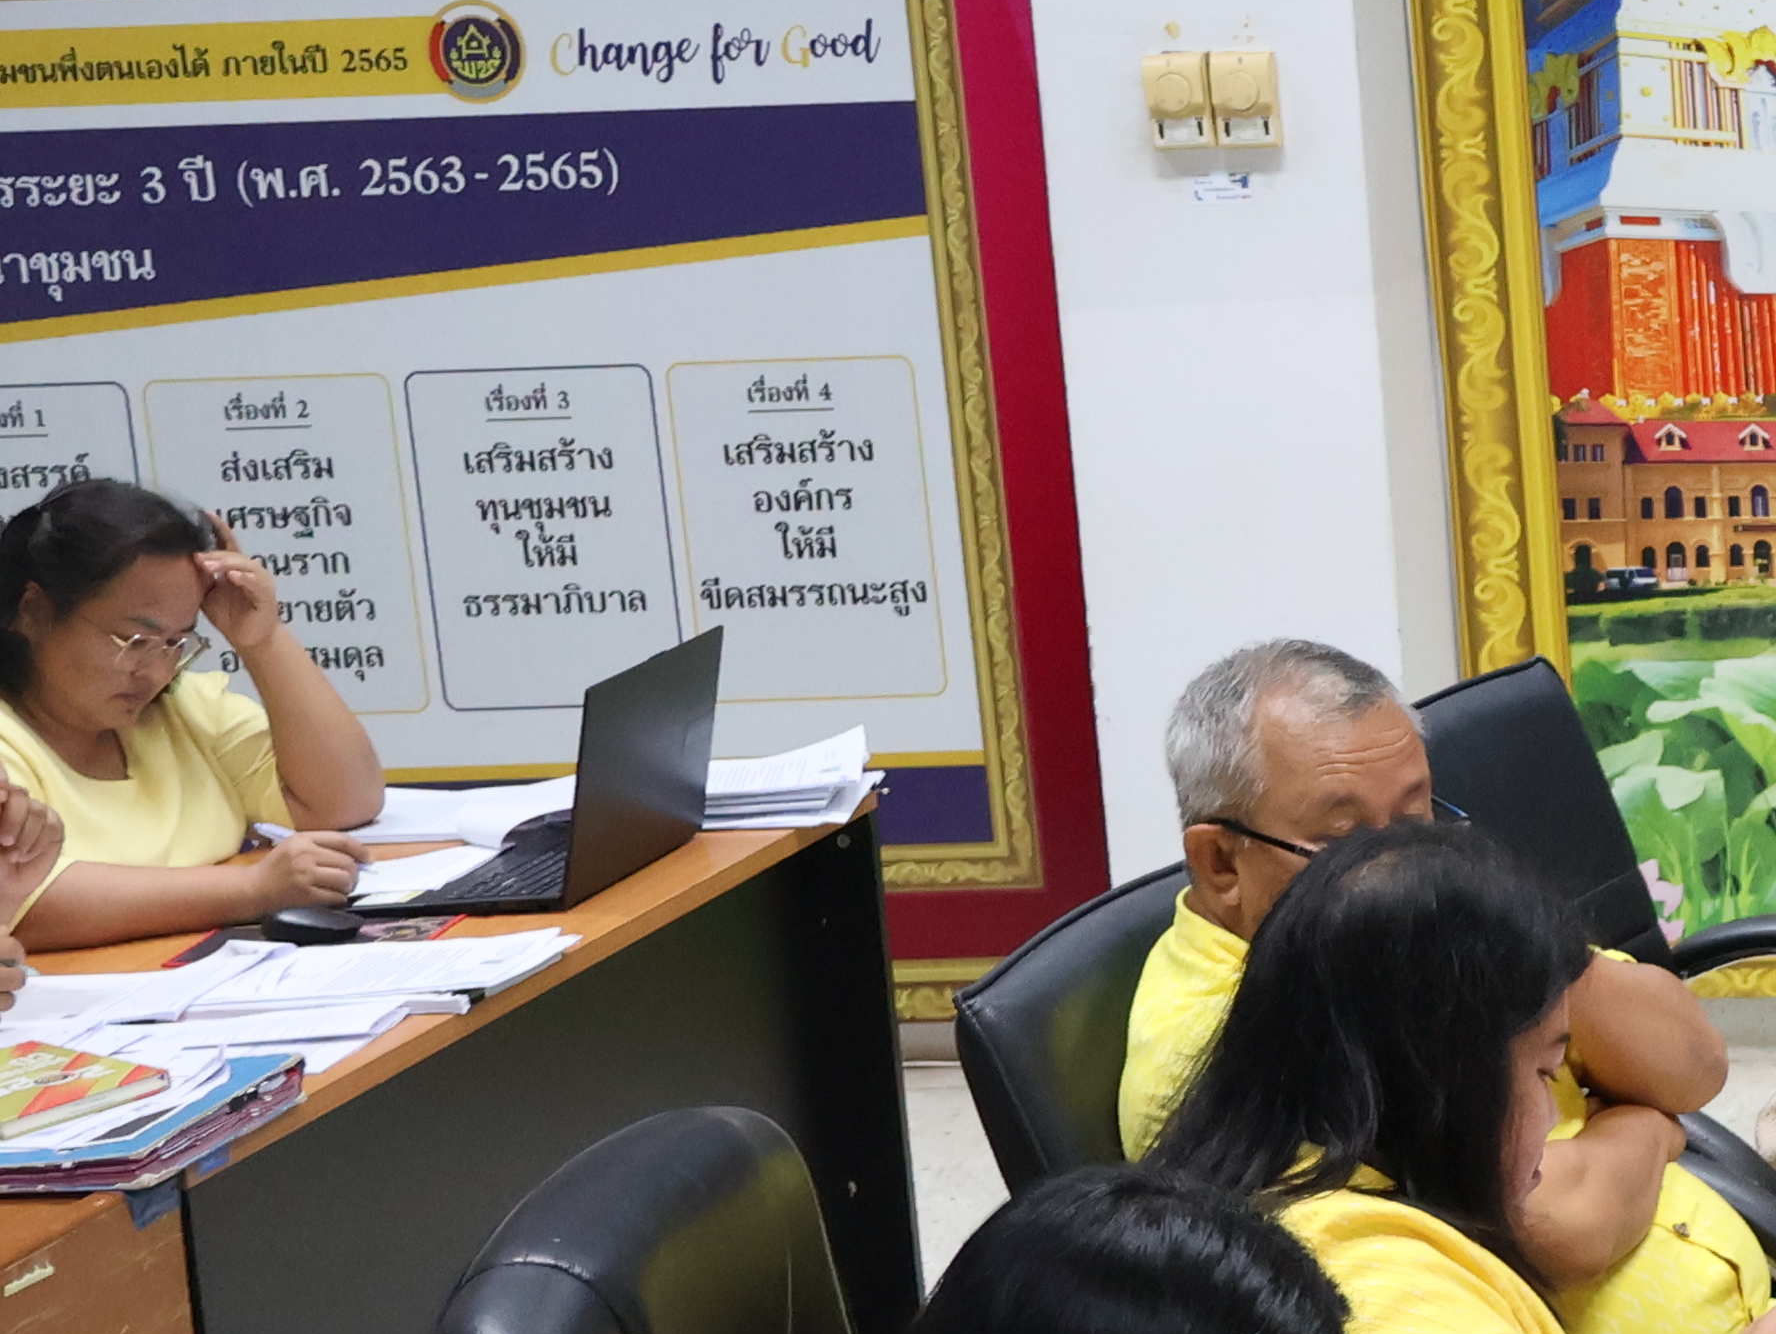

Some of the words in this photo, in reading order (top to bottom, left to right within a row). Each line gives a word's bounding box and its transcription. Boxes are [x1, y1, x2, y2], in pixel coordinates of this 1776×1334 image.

[222, 39, 328, 78] ภายในปี
[341, 46, 409, 76] 2565
[550, 27, 700, 84] Change
[710, 22, 770, 85] for
[780, 17, 881, 69] Good
[140, 166, 167, 205] 3
[178, 154, 218, 204] ปี
[237, 159, 342, 209] (พ.ศ.
[0, 248, 157, 302] าชุมชน
[223, 392, 287, 420] เรื่องที่
[297, 398, 311, 419] 2
[485, 382, 547, 413] เรื่องที่
[557, 390, 571, 411] 3
[746, 373, 809, 404] เรื่องที่
[818, 382, 834, 403] 4
[35, 408, 47, 428] 1
[220, 449, 335, 483] ส่งเสริม
[463, 437, 614, 474] เสริมสร้าง
[722, 428, 875, 467] เสริมสร้าง
[475, 493, 613, 535] ทุนชุมชน
[752, 477, 854, 514] องค์กร
[514, 529, 578, 569] ให้มี
[774, 521, 839, 561] ให้มี
[462, 581, 648, 618] ธรรมาภิบาล
[699, 577, 929, 617] ขีดสมรรถนะสูง
